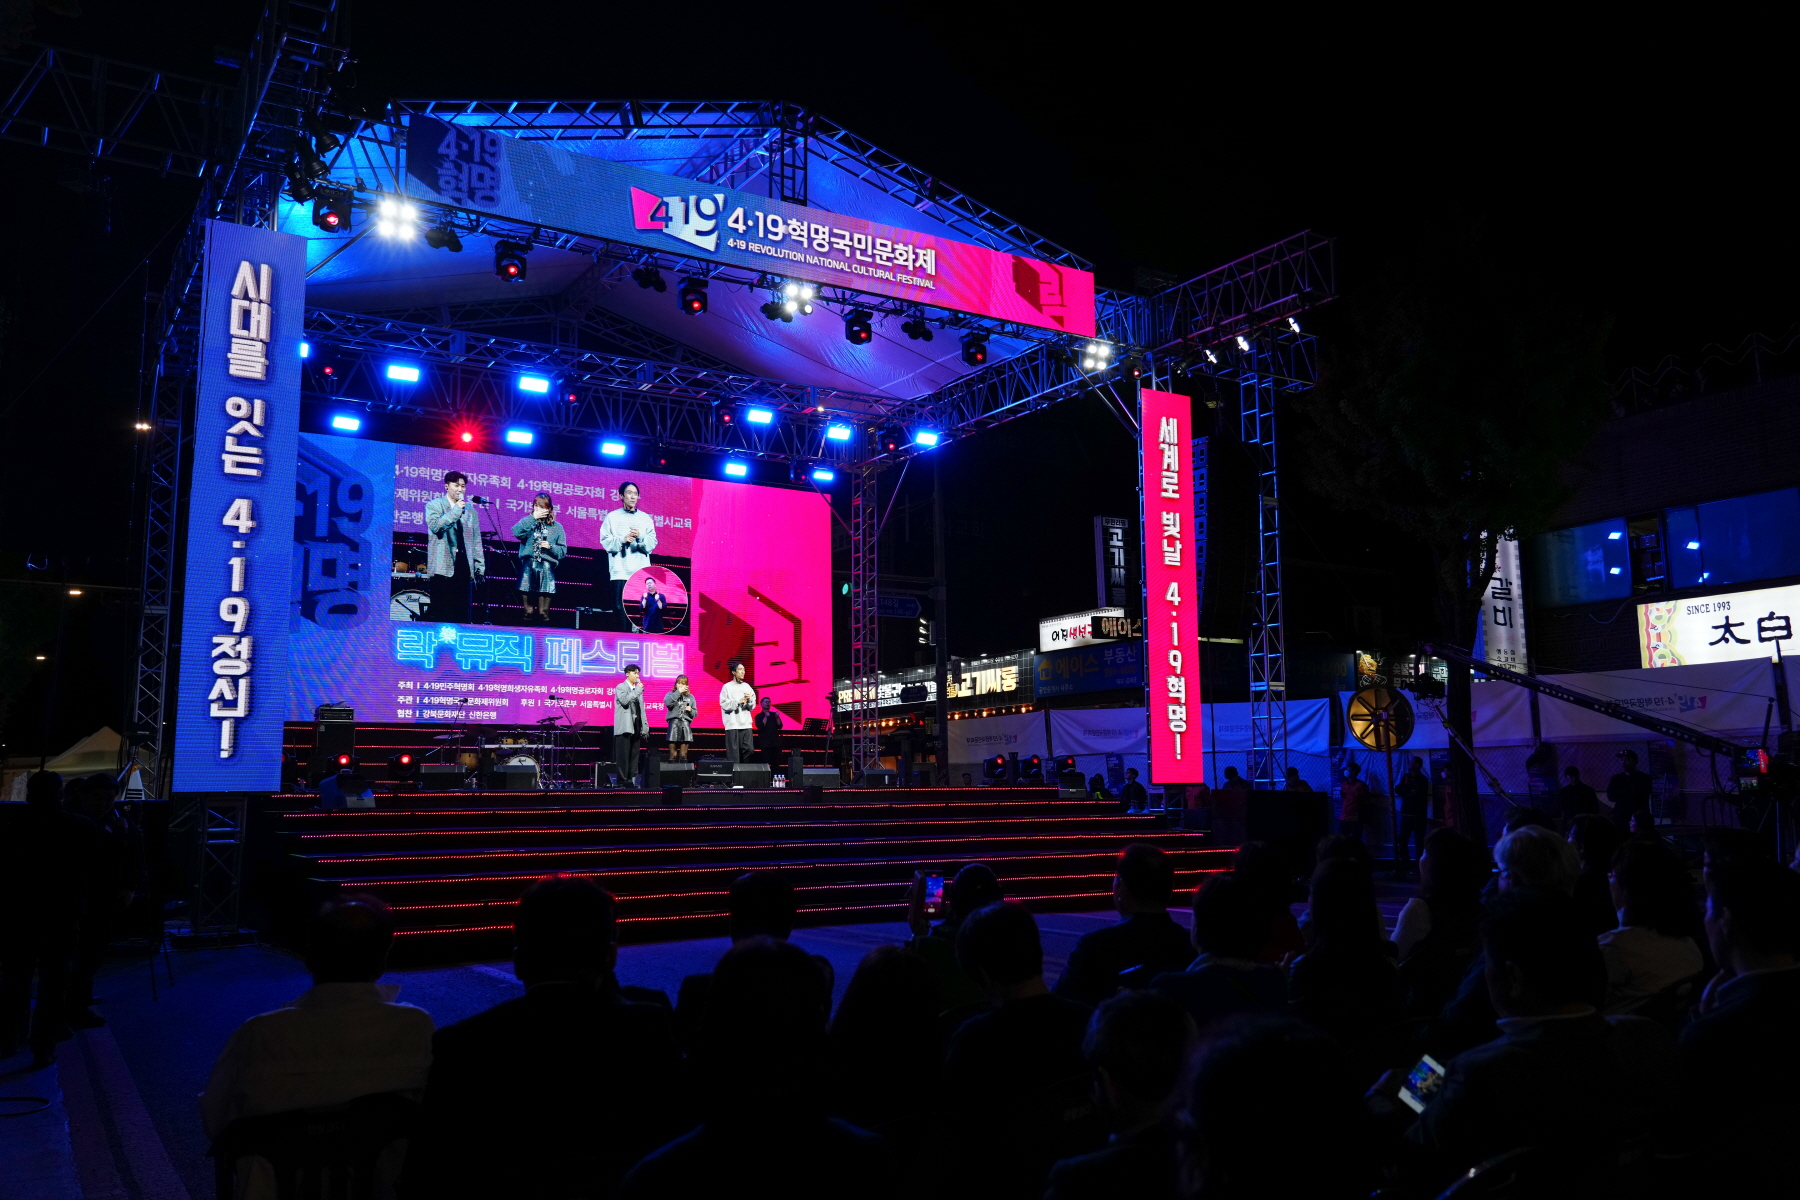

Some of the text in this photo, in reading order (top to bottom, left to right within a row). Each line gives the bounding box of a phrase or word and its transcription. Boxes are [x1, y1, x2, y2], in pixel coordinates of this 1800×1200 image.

[438, 160, 500, 208] 혁명
[727, 206, 936, 276] 4·19혁명국민문화제
[748, 241, 805, 263] REVOLUTION
[806, 254, 850, 272] NATIONAL
[852, 263, 895, 282] CULTURAL
[897, 273, 936, 290] FESTIVAL
[226, 259, 272, 382] 시대를
[221, 395, 265, 477] 잇는
[1158, 416, 1179, 500] 세계로
[1161, 510, 1182, 567] 빛날
[1490, 575, 1514, 629] 갈비
[1686, 601, 1731, 616] SINCE 1993
[397, 629, 438, 669] 락
[456, 632, 533, 673] 뮤직
[544, 637, 684, 678] 페스티벌
[1708, 611, 1794, 647] 太白
[397, 681, 414, 690] 주최
[1055, 653, 1100, 679] 에이스
[1103, 645, 1138, 665] 부동산
[397, 695, 413, 705] 주관
[422, 696, 509, 707] 4·19혁명국문화제위원회
[520, 698, 535, 707] 후원
[579, 700, 612, 709] 서울특별시
[468, 710, 497, 720] 신한은행
